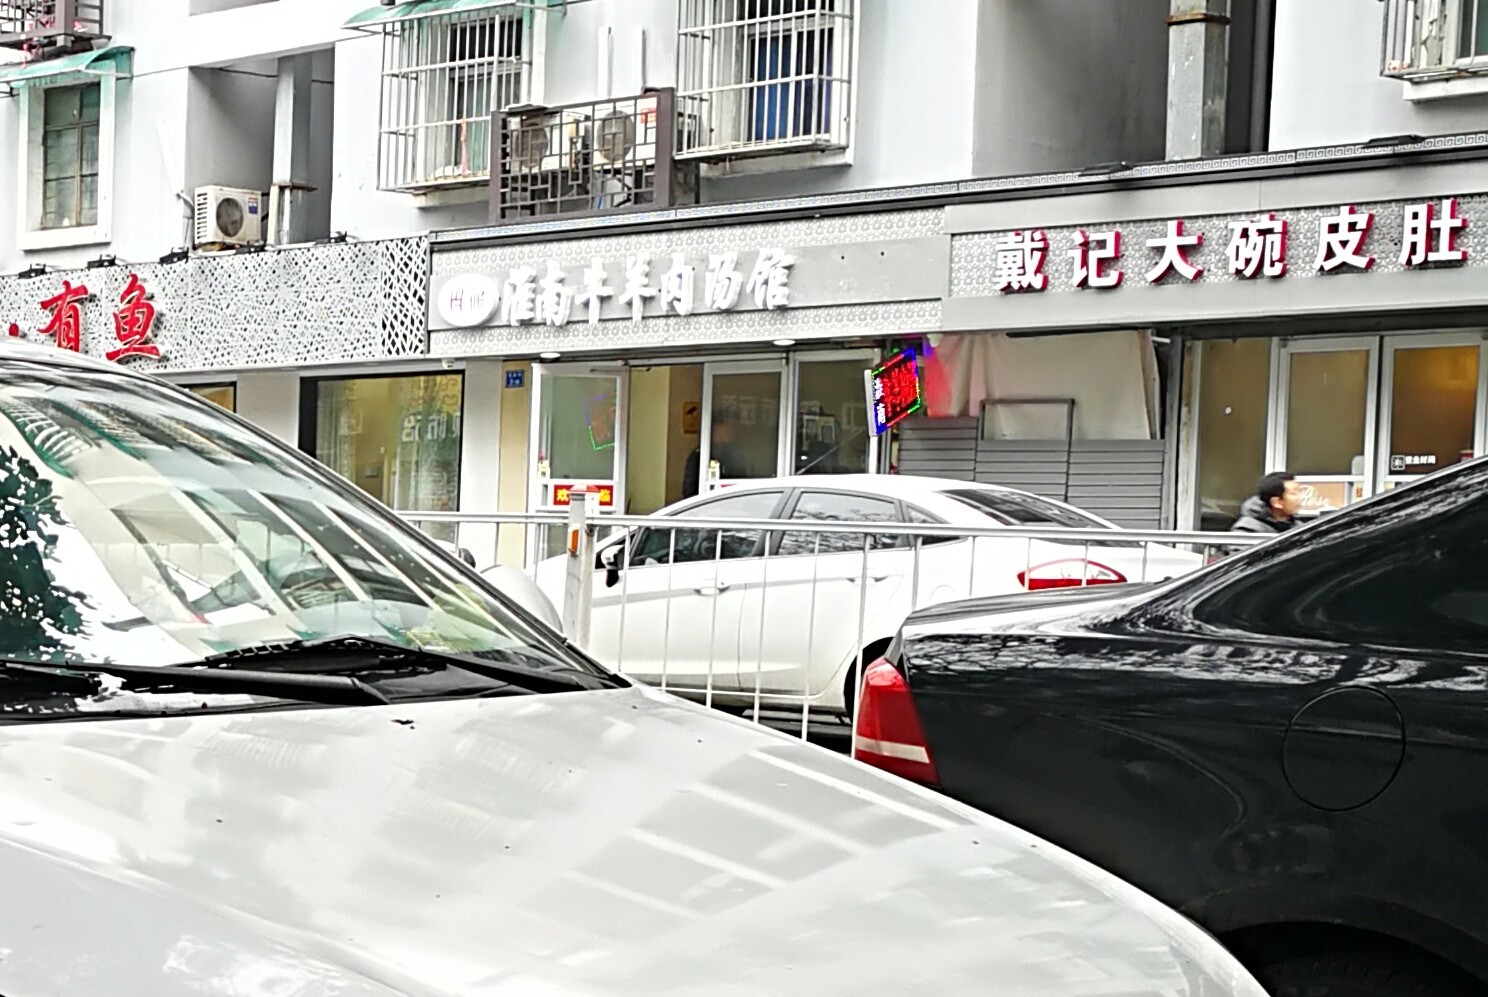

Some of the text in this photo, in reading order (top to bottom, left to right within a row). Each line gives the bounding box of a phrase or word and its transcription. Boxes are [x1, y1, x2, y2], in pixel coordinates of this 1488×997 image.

[994, 197, 1468, 294] 戴记大碗皮肚
[501, 249, 795, 326] 淮南牛羊肉汤馆
[556, 488, 611, 503] 欢临
